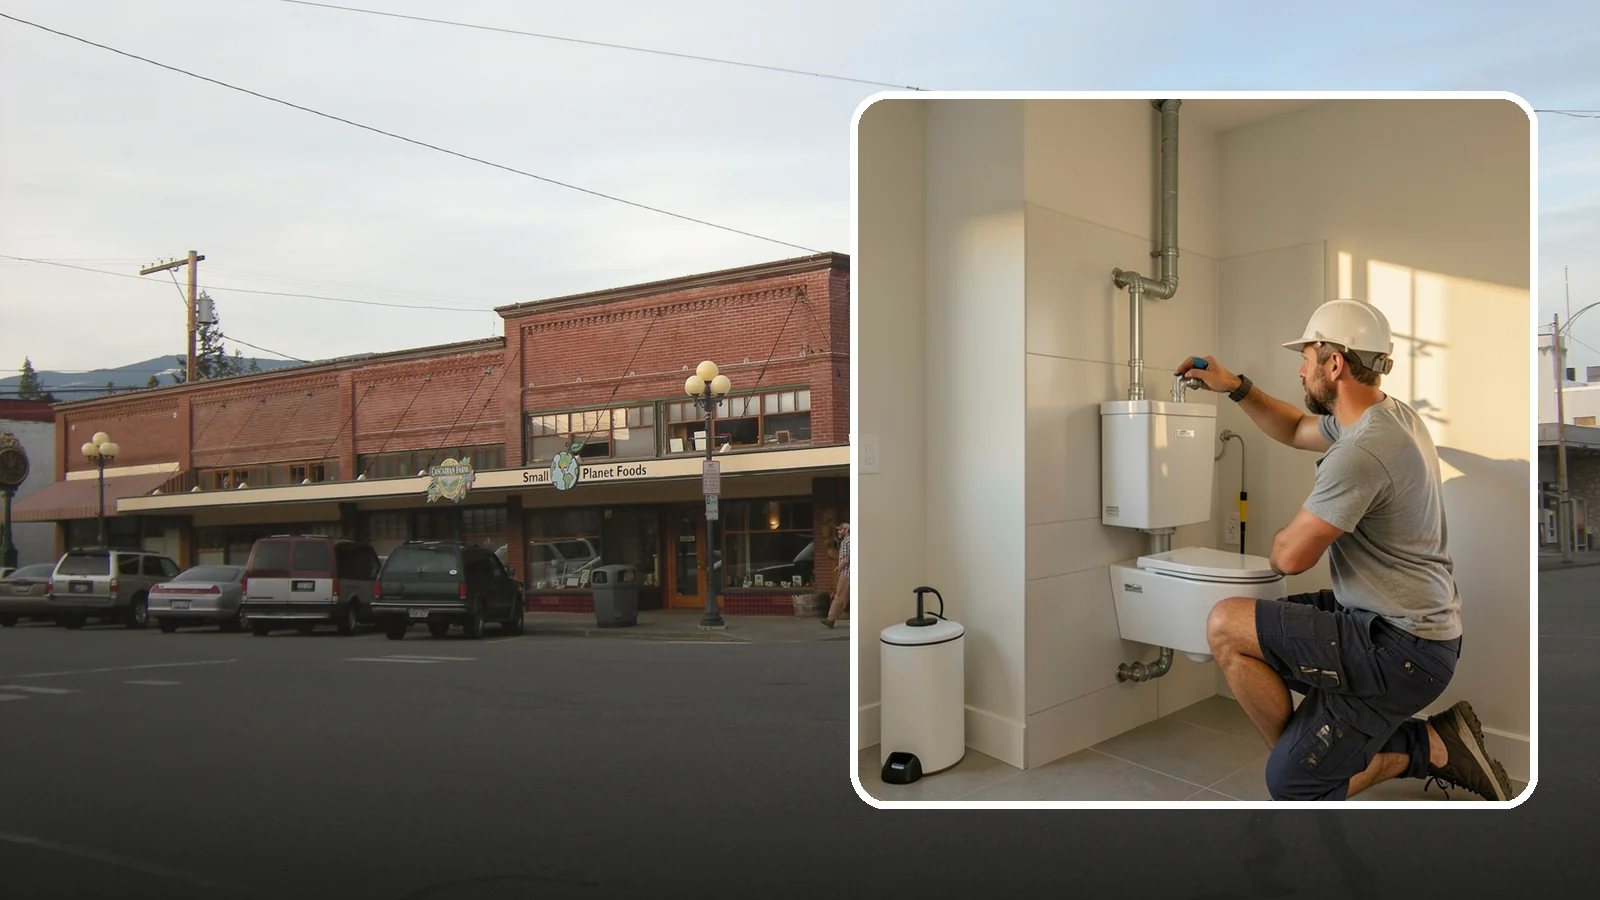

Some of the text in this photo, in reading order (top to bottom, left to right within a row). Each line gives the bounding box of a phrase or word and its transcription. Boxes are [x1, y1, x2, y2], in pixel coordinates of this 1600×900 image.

[523, 464, 647, 482] Small Planet Foods
